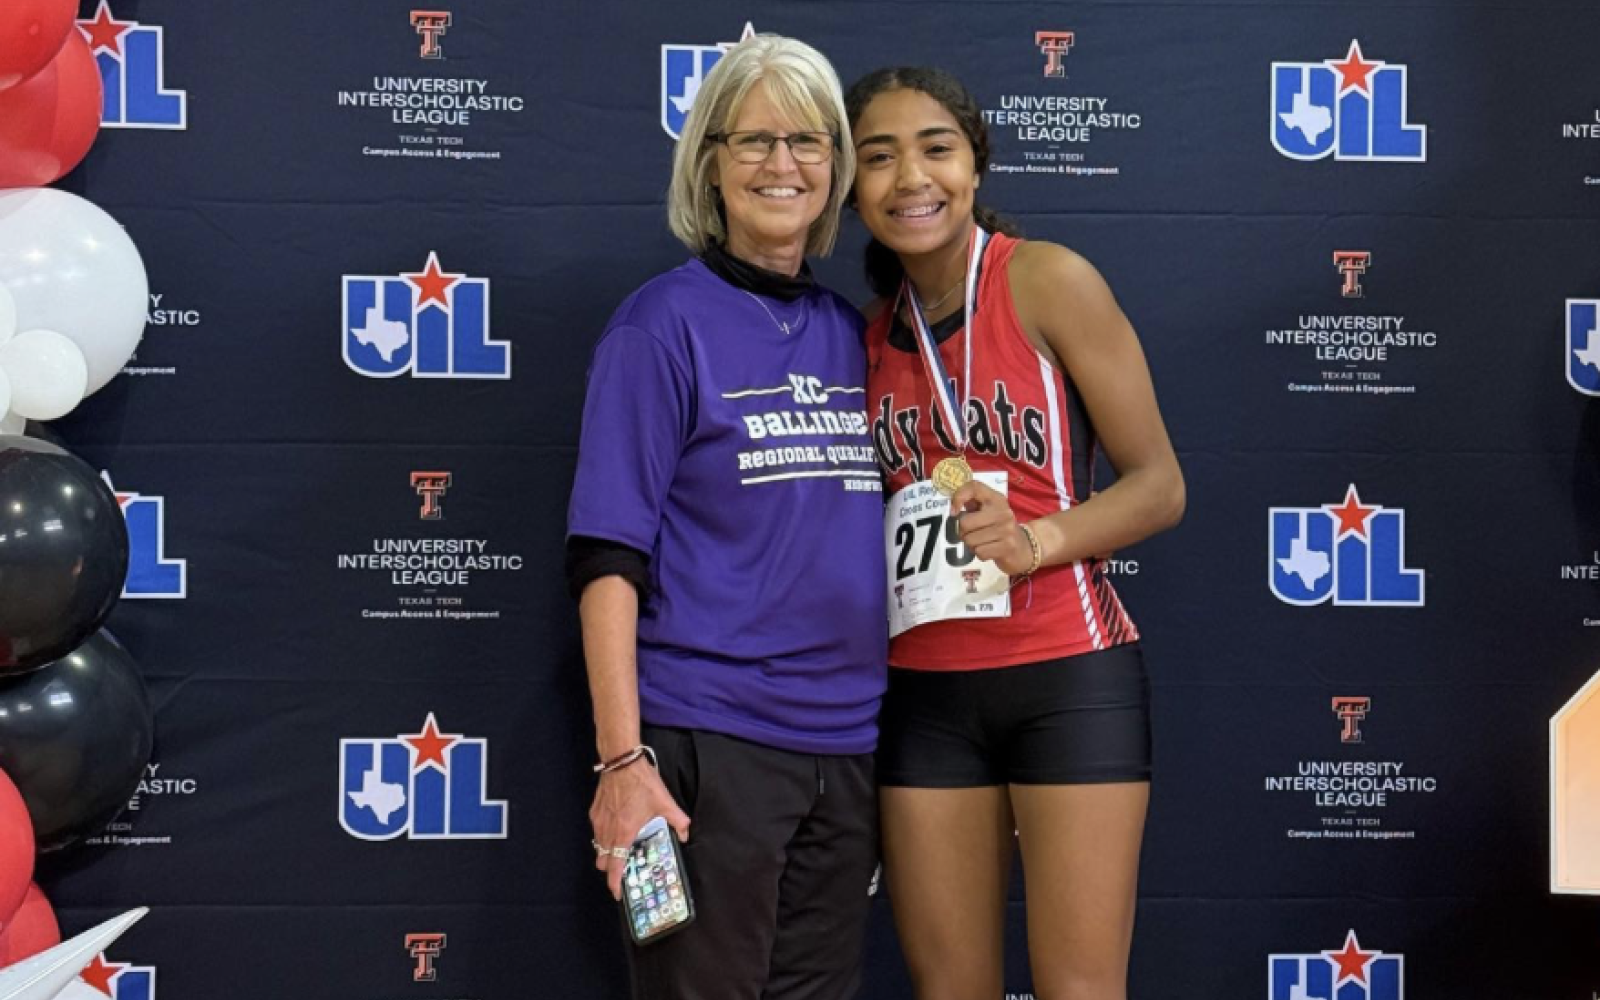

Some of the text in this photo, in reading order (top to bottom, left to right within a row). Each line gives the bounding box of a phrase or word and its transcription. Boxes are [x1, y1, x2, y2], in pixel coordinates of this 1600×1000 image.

[76, 0, 187, 130] IL
[373, 76, 488, 94] UNIVERSITY
[337, 91, 524, 111] INTERSCHOLASTIC
[1000, 95, 1108, 112] UNIVERSITY
[1269, 38, 1427, 162] UIL
[392, 109, 470, 125] LEAGUE
[981, 109, 1141, 128] TERSCHOLASTIC
[399, 135, 463, 145] TEXAS TECH
[1018, 126, 1091, 142] LEAGUE
[362, 146, 500, 159] Campus Access & Engagement
[1024, 152, 1084, 162] TEXAS TECH
[989, 163, 1119, 175] Campus Access & Engagement
[341, 251, 511, 380] UIL
[1299, 315, 1404, 330] UNIVERSITY
[1266, 330, 1437, 346] INTERSCHOLASTIC
[1316, 346, 1387, 360] LEAGUE
[1321, 372, 1380, 380] TEXAS TECH
[788, 373, 829, 404] XC
[1288, 383, 1322, 393] Campus
[1324, 384, 1354, 392] Access
[1363, 384, 1415, 394] Engagement
[873, 394, 924, 482] dy
[373, 539, 487, 554] UNIVERSITY
[895, 511, 976, 581] 279
[1268, 483, 1425, 606] UIL
[337, 554, 523, 570] INTERSCHOLASTIC
[391, 570, 469, 585] LEAGUE
[399, 597, 462, 605] TEXAS TECH
[362, 609, 500, 619] Campus Access & Engagement
[338, 710, 508, 841] UIL
[1299, 761, 1404, 776] UNIVERSITY
[1265, 776, 1437, 792] INTERSCHOLASTIC
[1315, 792, 1387, 807] LEAGUE
[1321, 818, 1380, 826] TEXAS TECH
[1288, 829, 1322, 839] Campus
[1323, 830, 1353, 838] Access
[1363, 830, 1415, 839] Engagement
